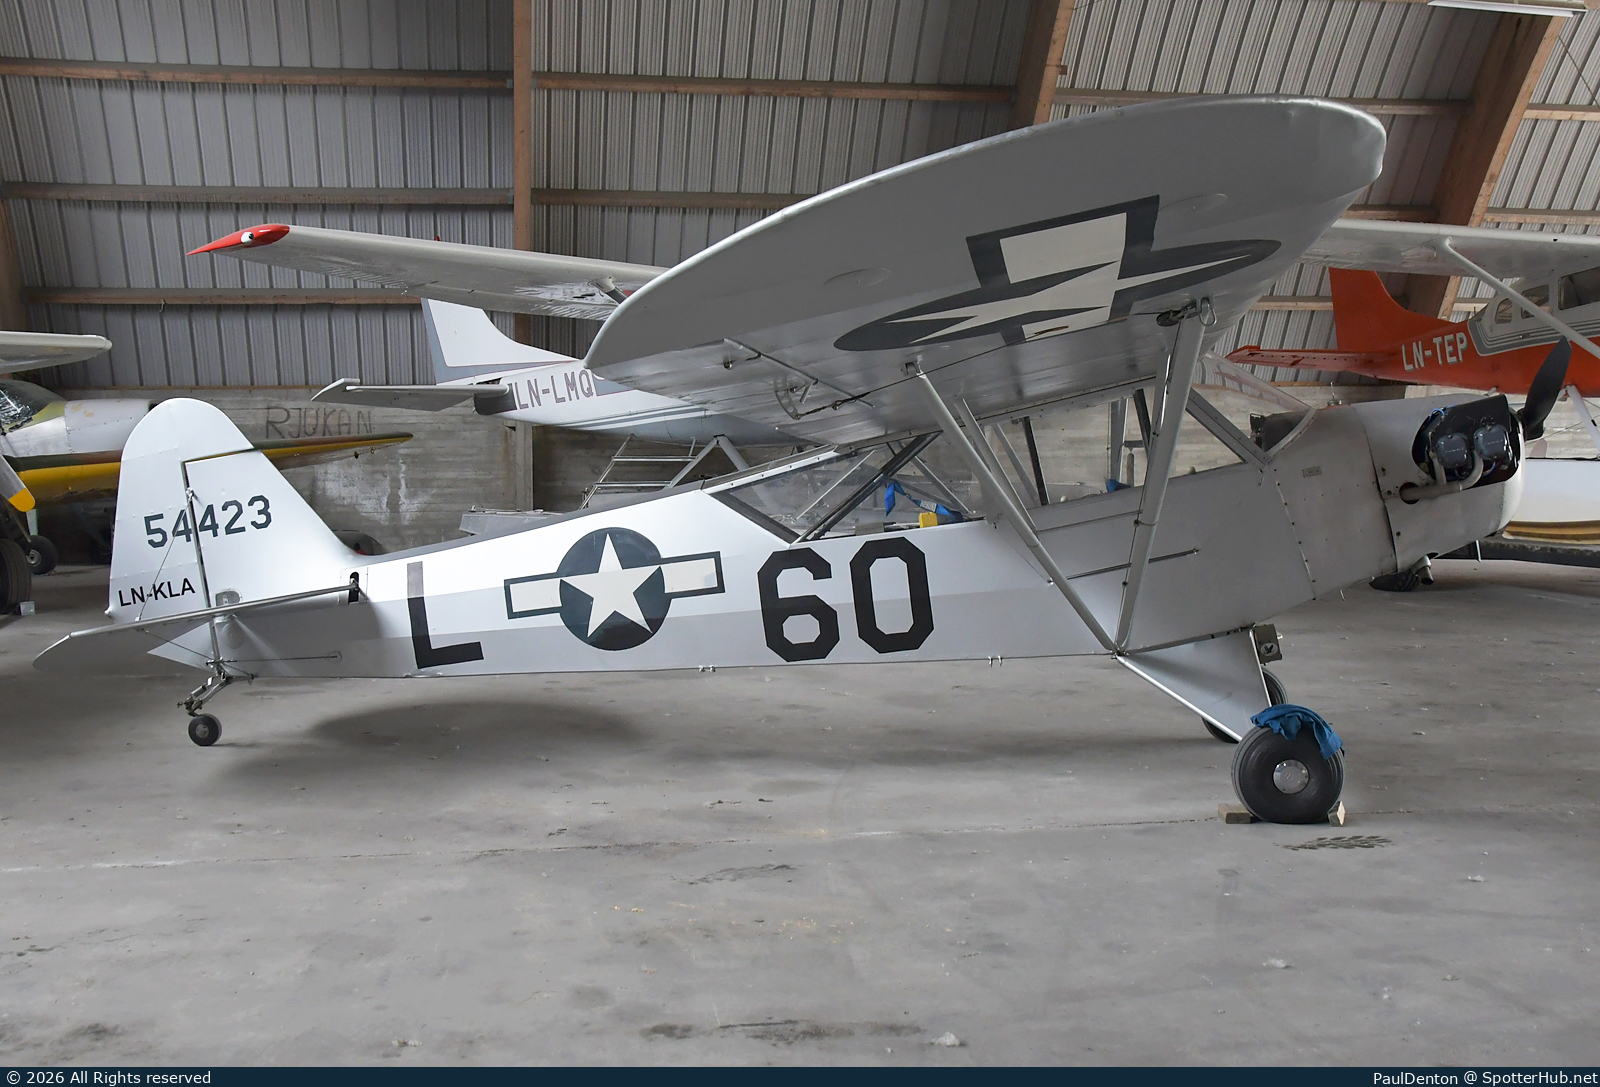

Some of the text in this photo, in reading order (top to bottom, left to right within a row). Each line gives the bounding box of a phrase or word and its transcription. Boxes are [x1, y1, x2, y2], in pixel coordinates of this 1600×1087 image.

[1401, 331, 1468, 371] LN-TEP
[514, 369, 594, 410] LN-LMQ
[265, 405, 373, 439] RJUKAN
[144, 494, 272, 549] 54423
[118, 577, 196, 607] LN-KLA
[406, 536, 935, 670] L 60
